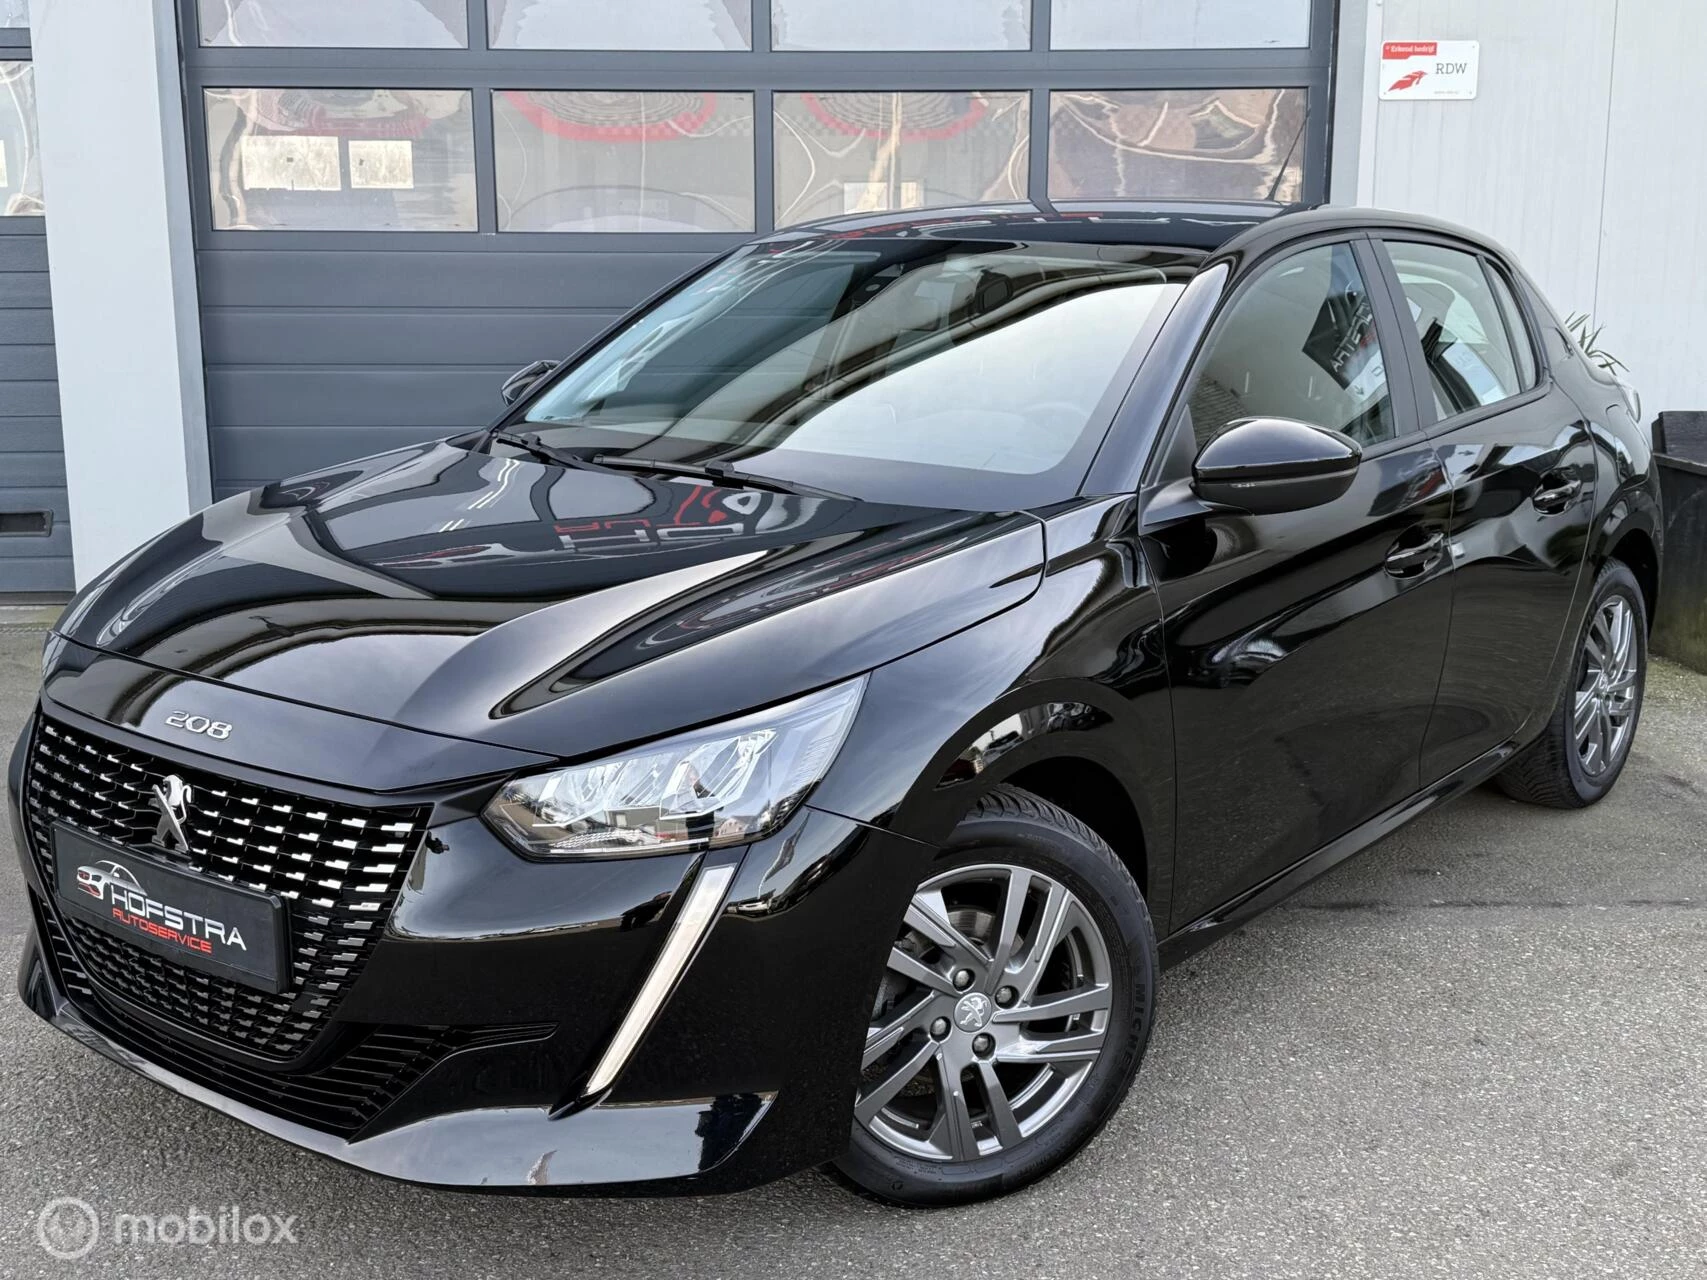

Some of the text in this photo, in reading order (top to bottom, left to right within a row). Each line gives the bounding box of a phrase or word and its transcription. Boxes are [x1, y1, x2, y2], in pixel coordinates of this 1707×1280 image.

[1435, 62, 1467, 75] RDW
[165, 710, 233, 740] 208
[110, 884, 247, 951] HOFSTRA
[112, 908, 213, 954] AUTOSERVICE
